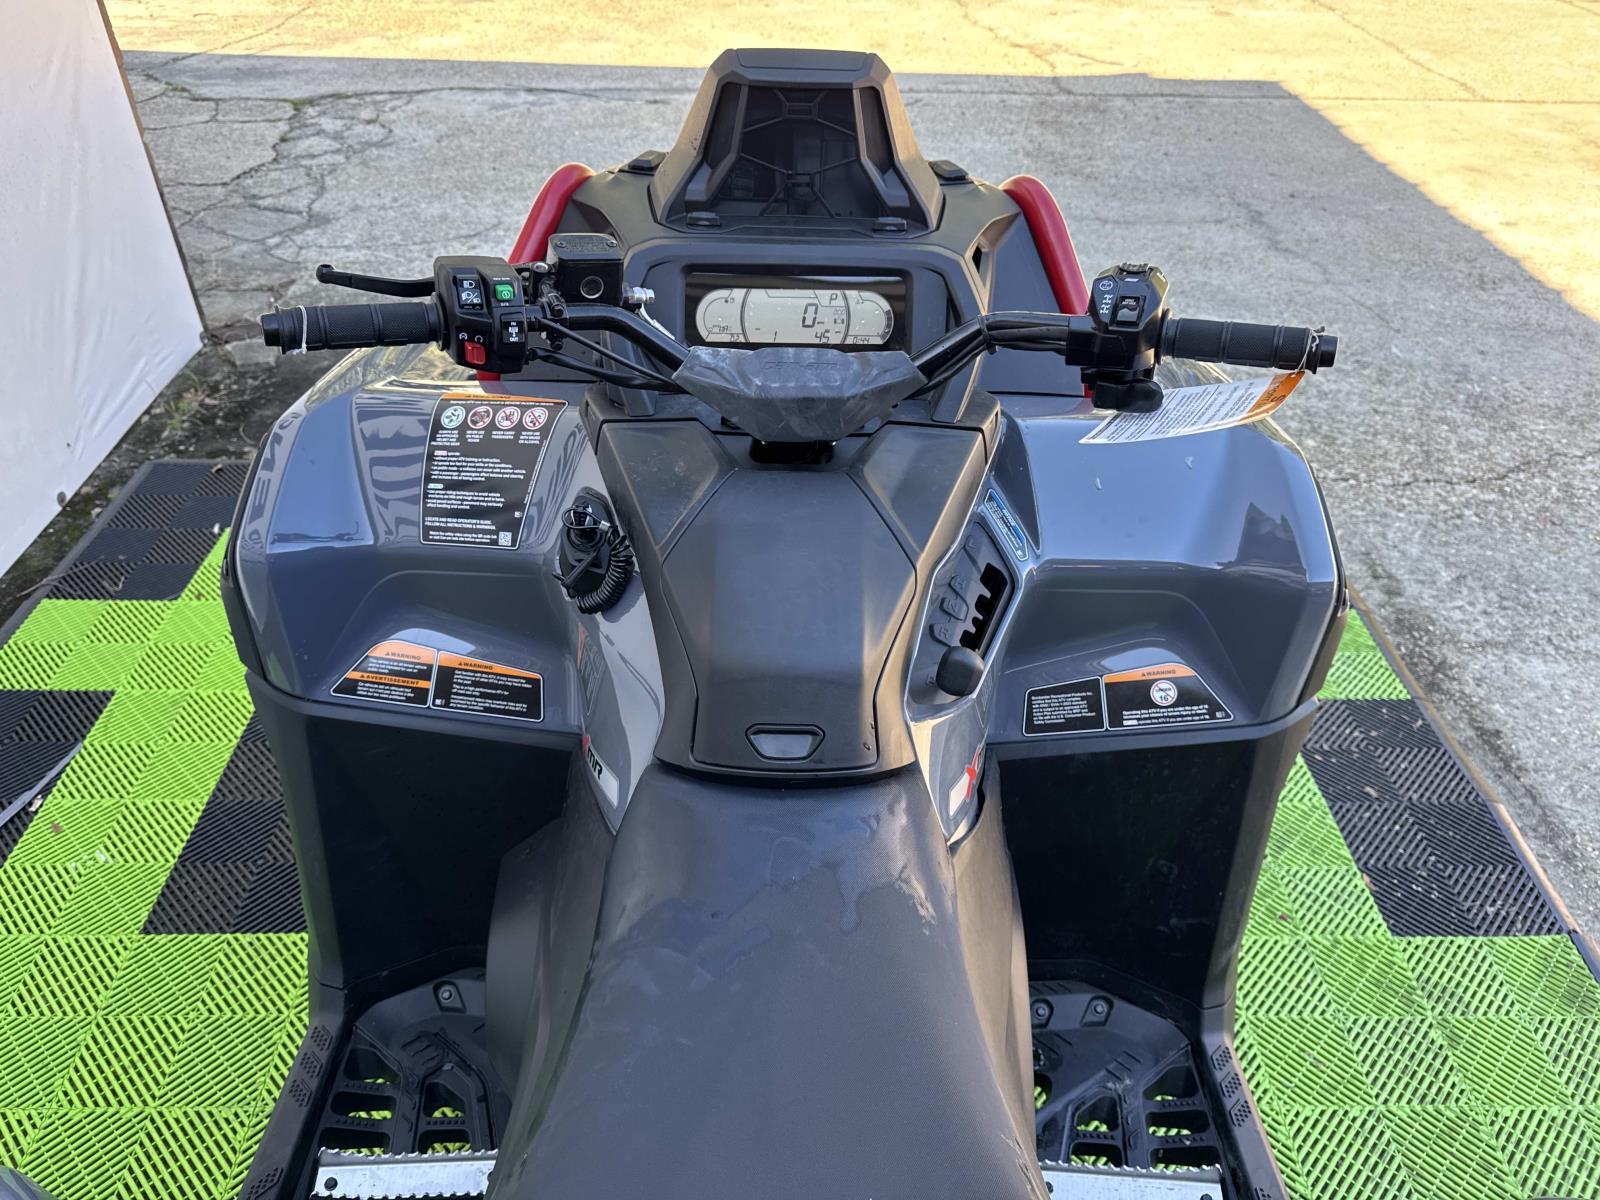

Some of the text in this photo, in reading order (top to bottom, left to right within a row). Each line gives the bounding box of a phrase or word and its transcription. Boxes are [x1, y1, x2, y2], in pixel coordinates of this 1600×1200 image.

[829, 293, 838, 304] P
[802, 303, 818, 328] 0
[391, 652, 422, 660] WARNING
[367, 674, 420, 685] AVERTISSEMENT
